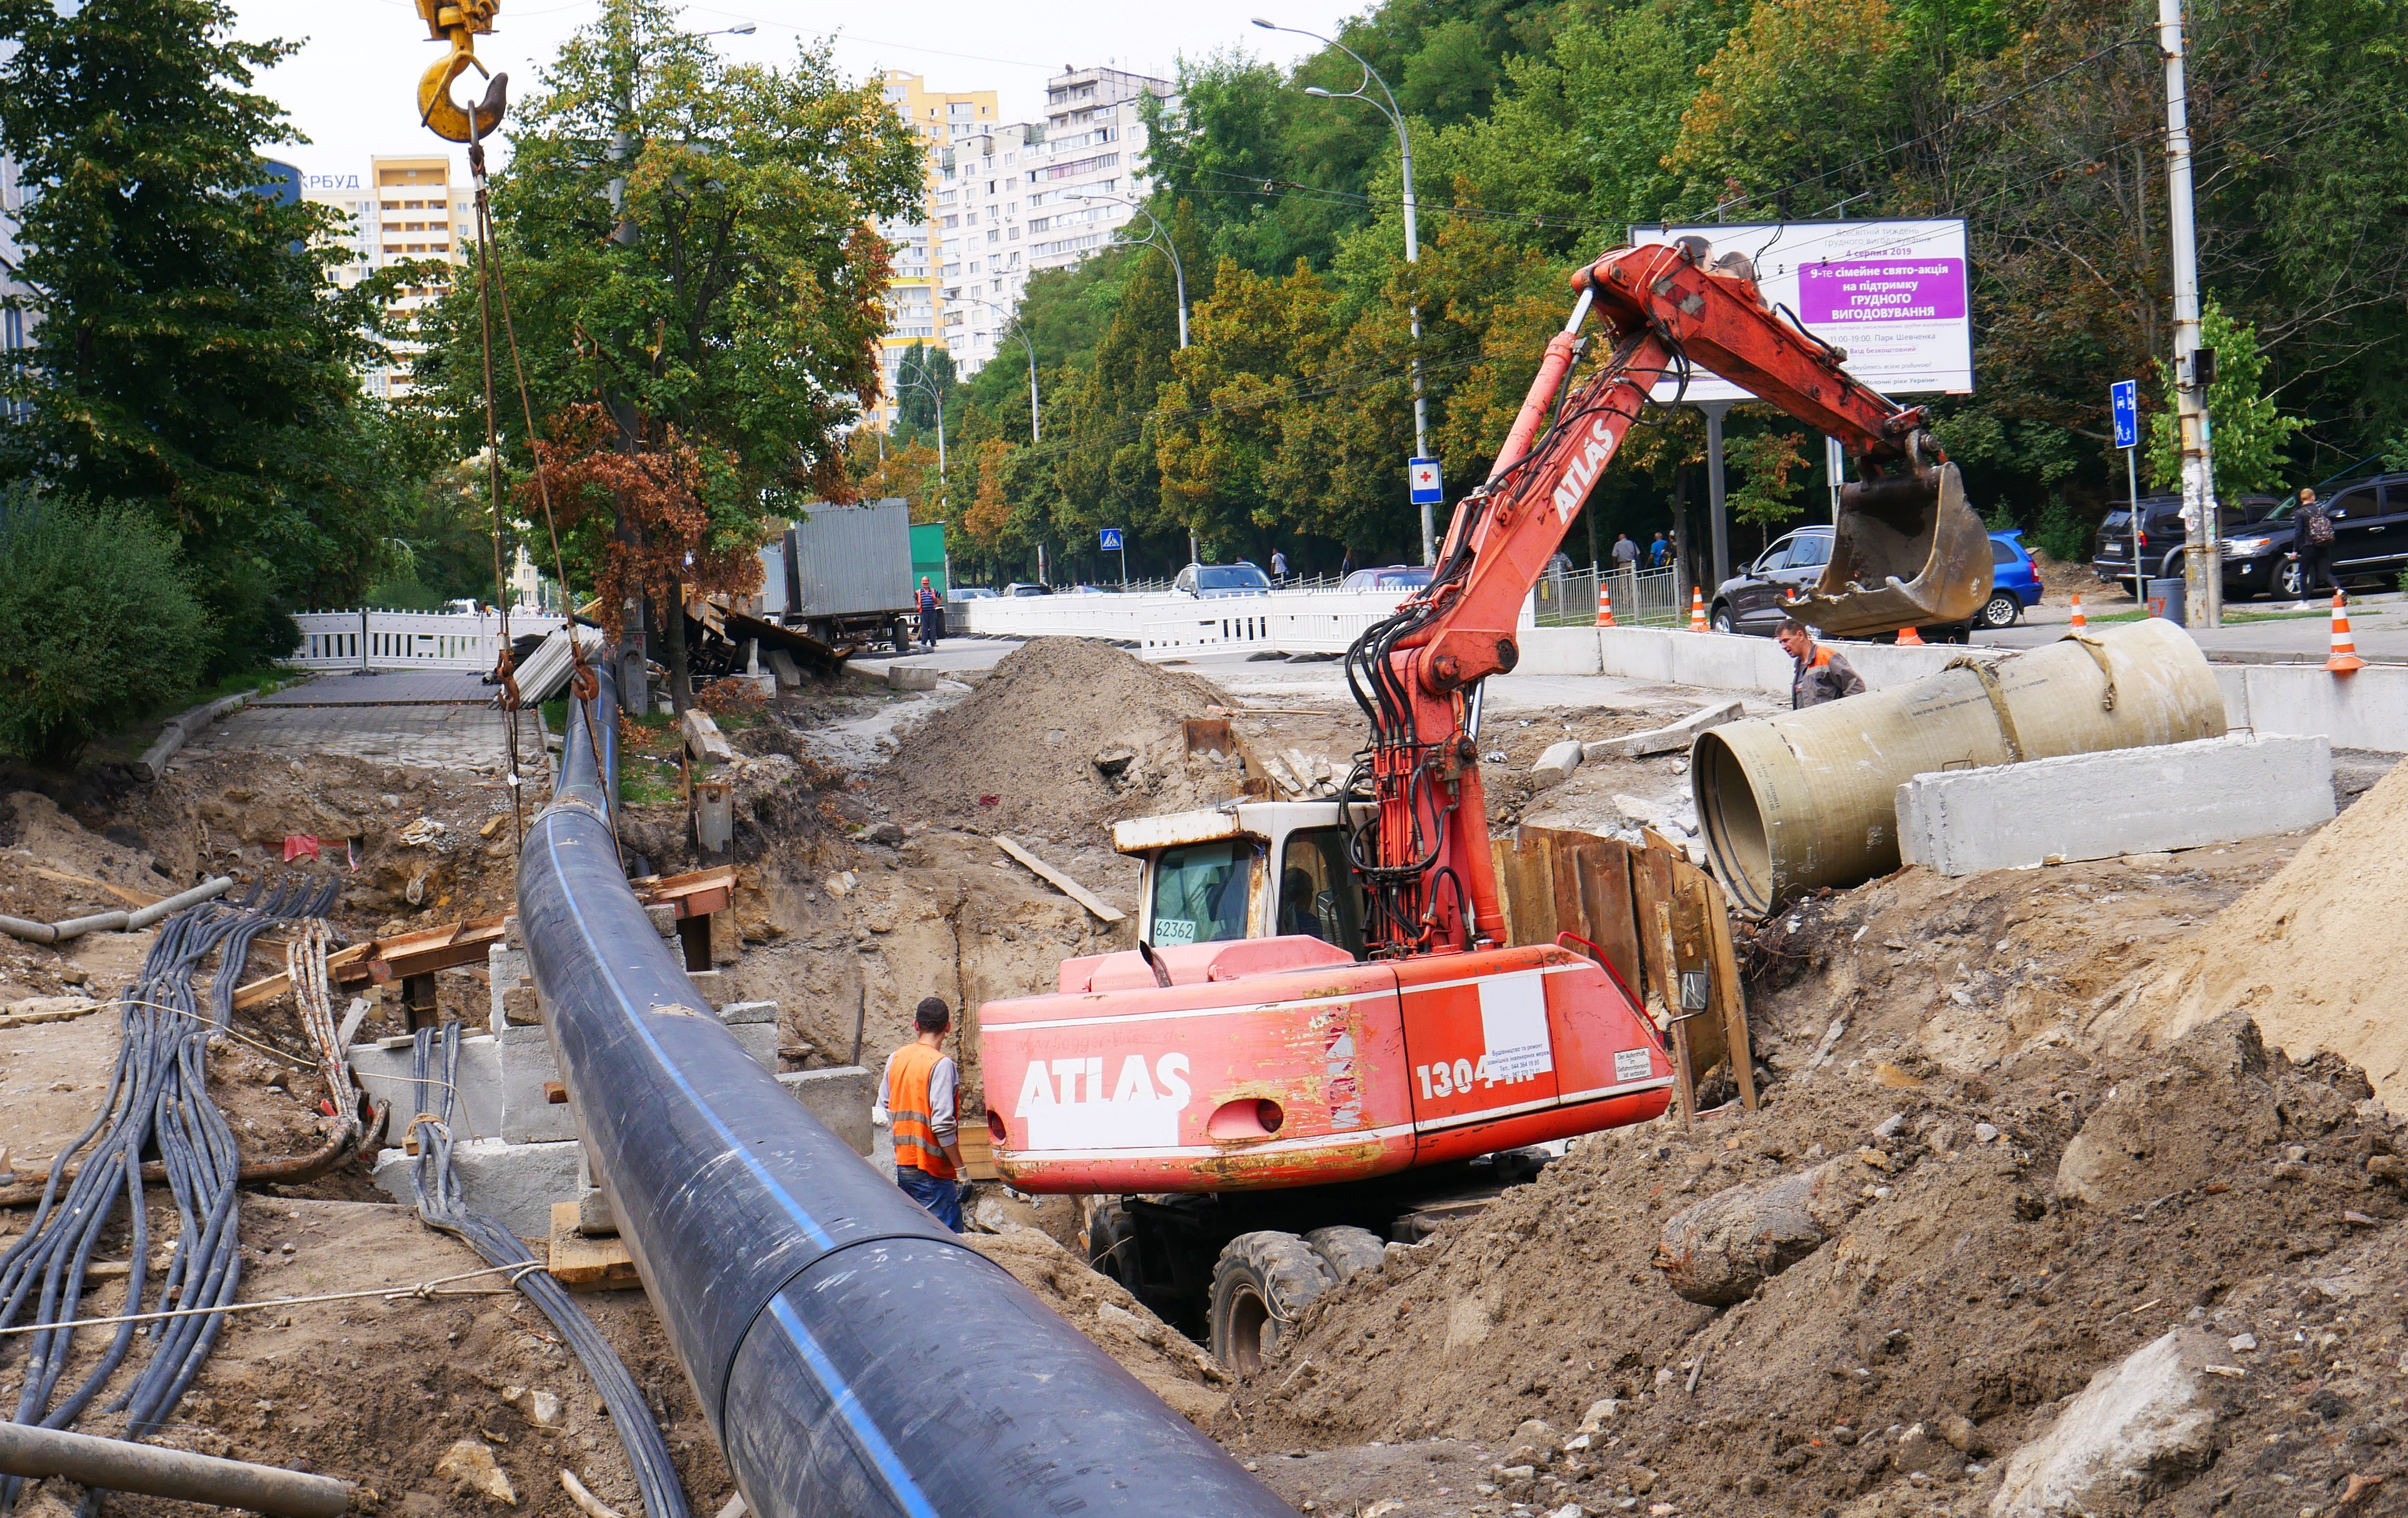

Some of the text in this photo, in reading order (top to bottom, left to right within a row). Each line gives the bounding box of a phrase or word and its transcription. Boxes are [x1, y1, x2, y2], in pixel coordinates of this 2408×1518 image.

[1836, 227, 1919, 237] Всесвітній тиждень
[1824, 236, 1932, 247] грудного вигодовування
[1854, 250, 1888, 258] серпня
[1890, 248, 1912, 256] 2019
[1811, 264, 1949, 278] 9-те сімейне свято-акція
[1842, 280, 1919, 293] на підтримку
[1851, 293, 1912, 306] ГРУДНОГО
[1831, 306, 1936, 320] ВИГОДОВУВАННЯ
[1875, 334, 1894, 343] Парк
[1896, 333, 1936, 341] Шевченка
[1866, 345, 1917, 354] безкоштовний
[1553, 418, 1613, 525] ATLAS
[1156, 921, 1193, 939] 62362
[1416, 1054, 1494, 1100] 1304
[1014, 1052, 1192, 1118] ATLAS
